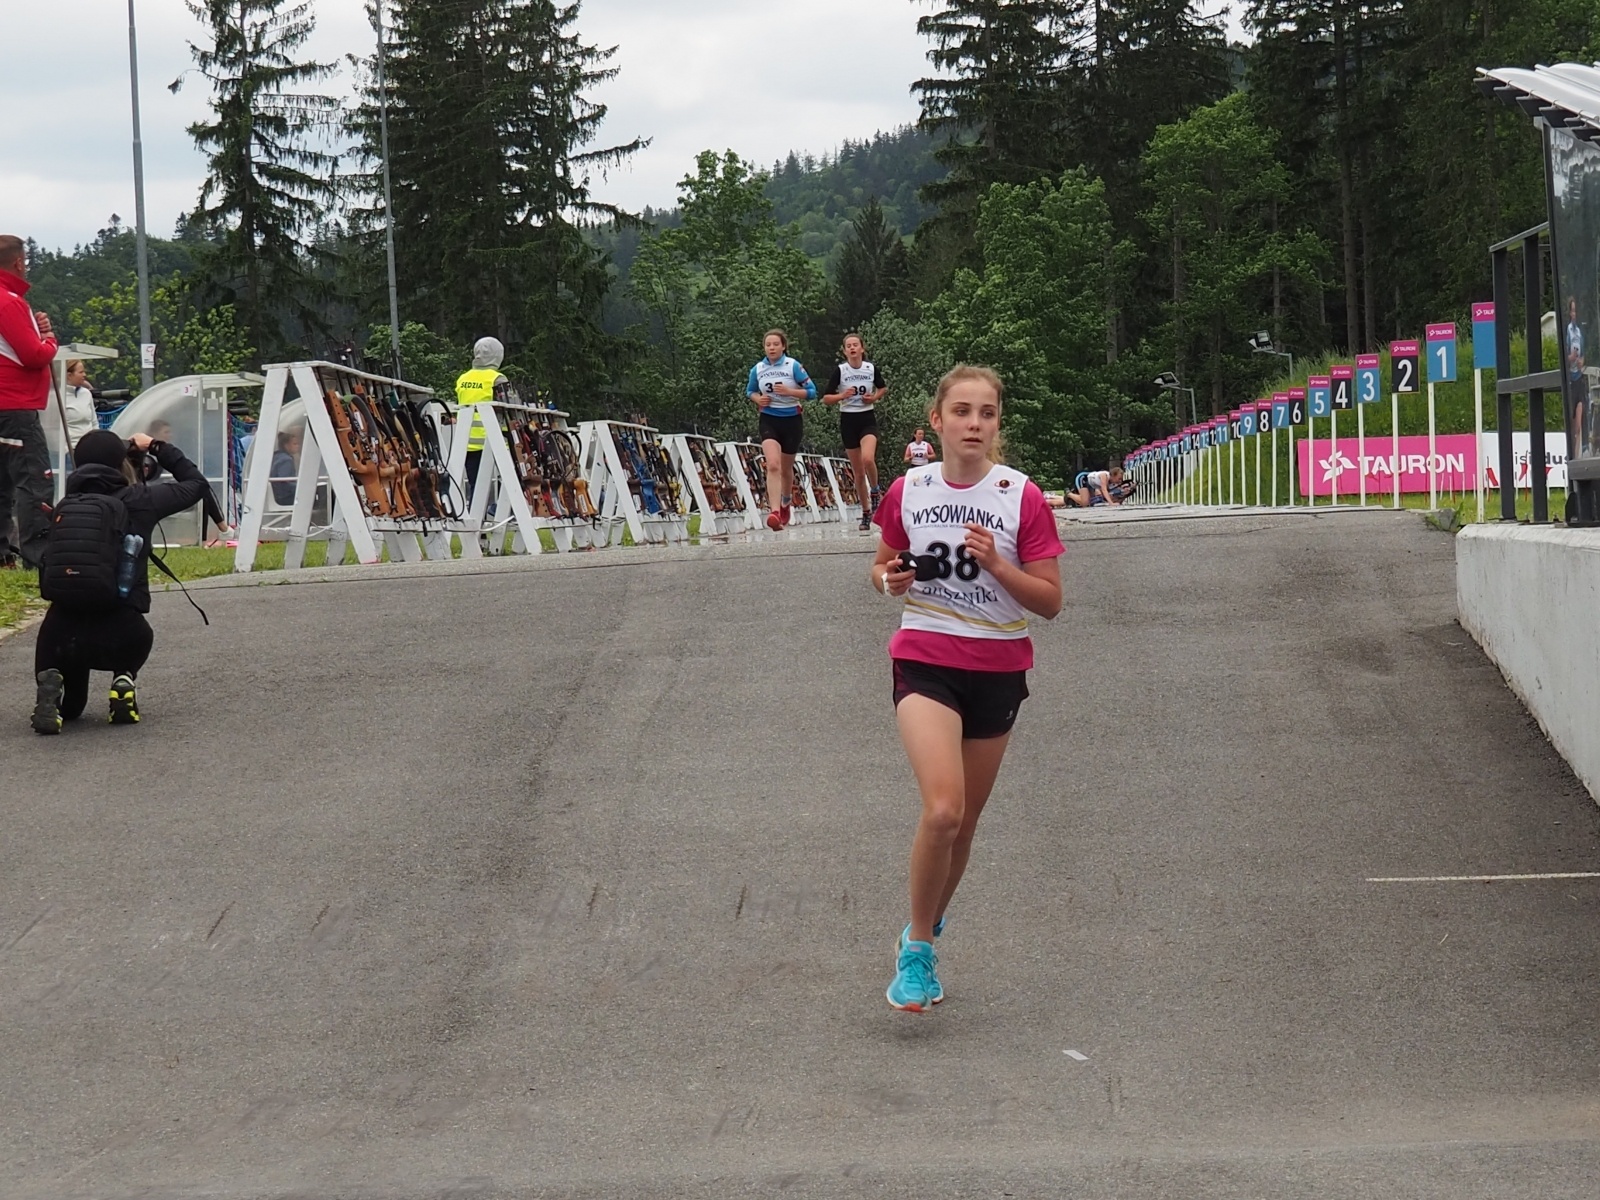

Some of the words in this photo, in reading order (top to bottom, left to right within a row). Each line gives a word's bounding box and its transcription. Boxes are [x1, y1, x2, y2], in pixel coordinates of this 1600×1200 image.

[1436, 346, 1447, 378] 1
[1398, 358, 1413, 392] 2
[1335, 381, 1348, 409] 4
[1362, 371, 1375, 402] 3
[1292, 402, 1302, 424] 6
[1314, 392, 1325, 414] 5
[1244, 416, 1252, 434] 9
[1260, 411, 1269, 432] 8
[1276, 406, 1285, 426] 7
[1217, 426, 1228, 443] 11
[1232, 421, 1241, 438] 10
[1192, 434, 1200, 449] 14
[1358, 453, 1465, 476] TAURON
[912, 504, 1004, 531] WYSOWIANKA
[926, 540, 980, 582] 38
